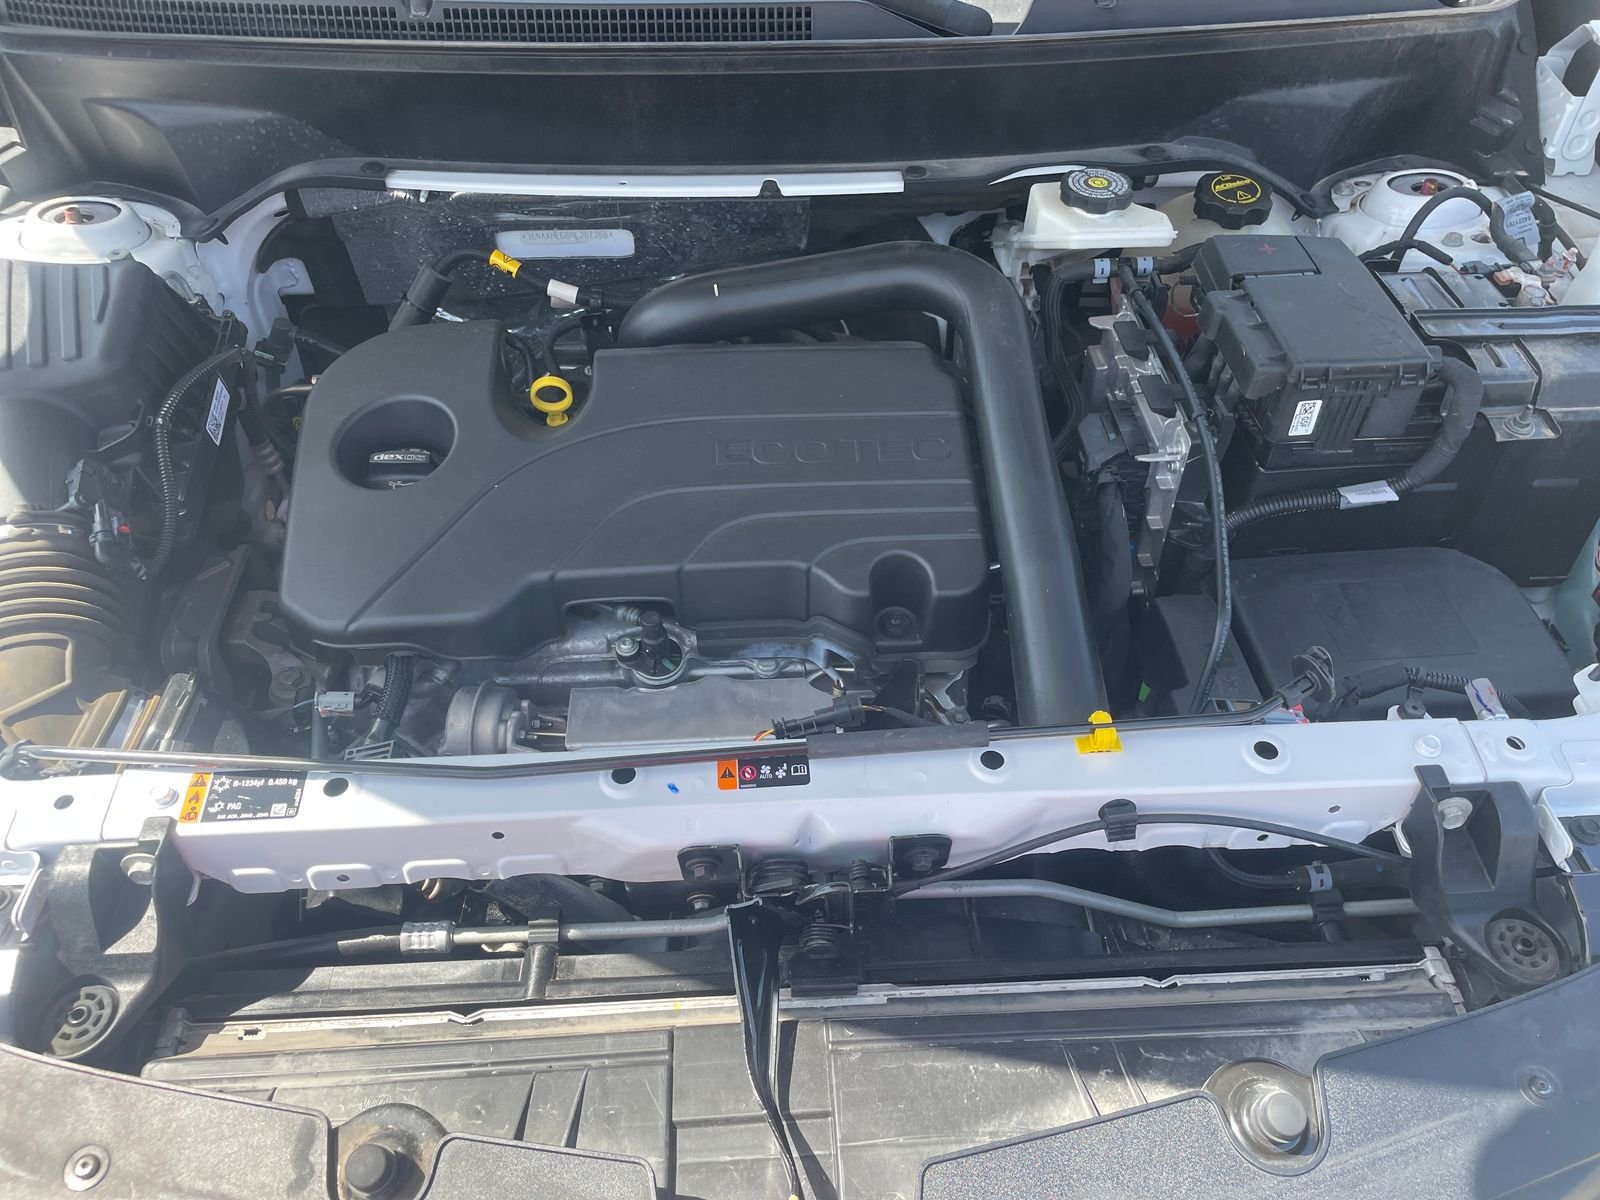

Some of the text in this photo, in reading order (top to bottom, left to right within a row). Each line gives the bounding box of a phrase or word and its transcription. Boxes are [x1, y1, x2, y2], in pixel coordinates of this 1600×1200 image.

[715, 438, 951, 465] ECOTEC
[232, 778, 298, 788] R-1234yf 0.450 kg
[226, 802, 242, 810] PAG
